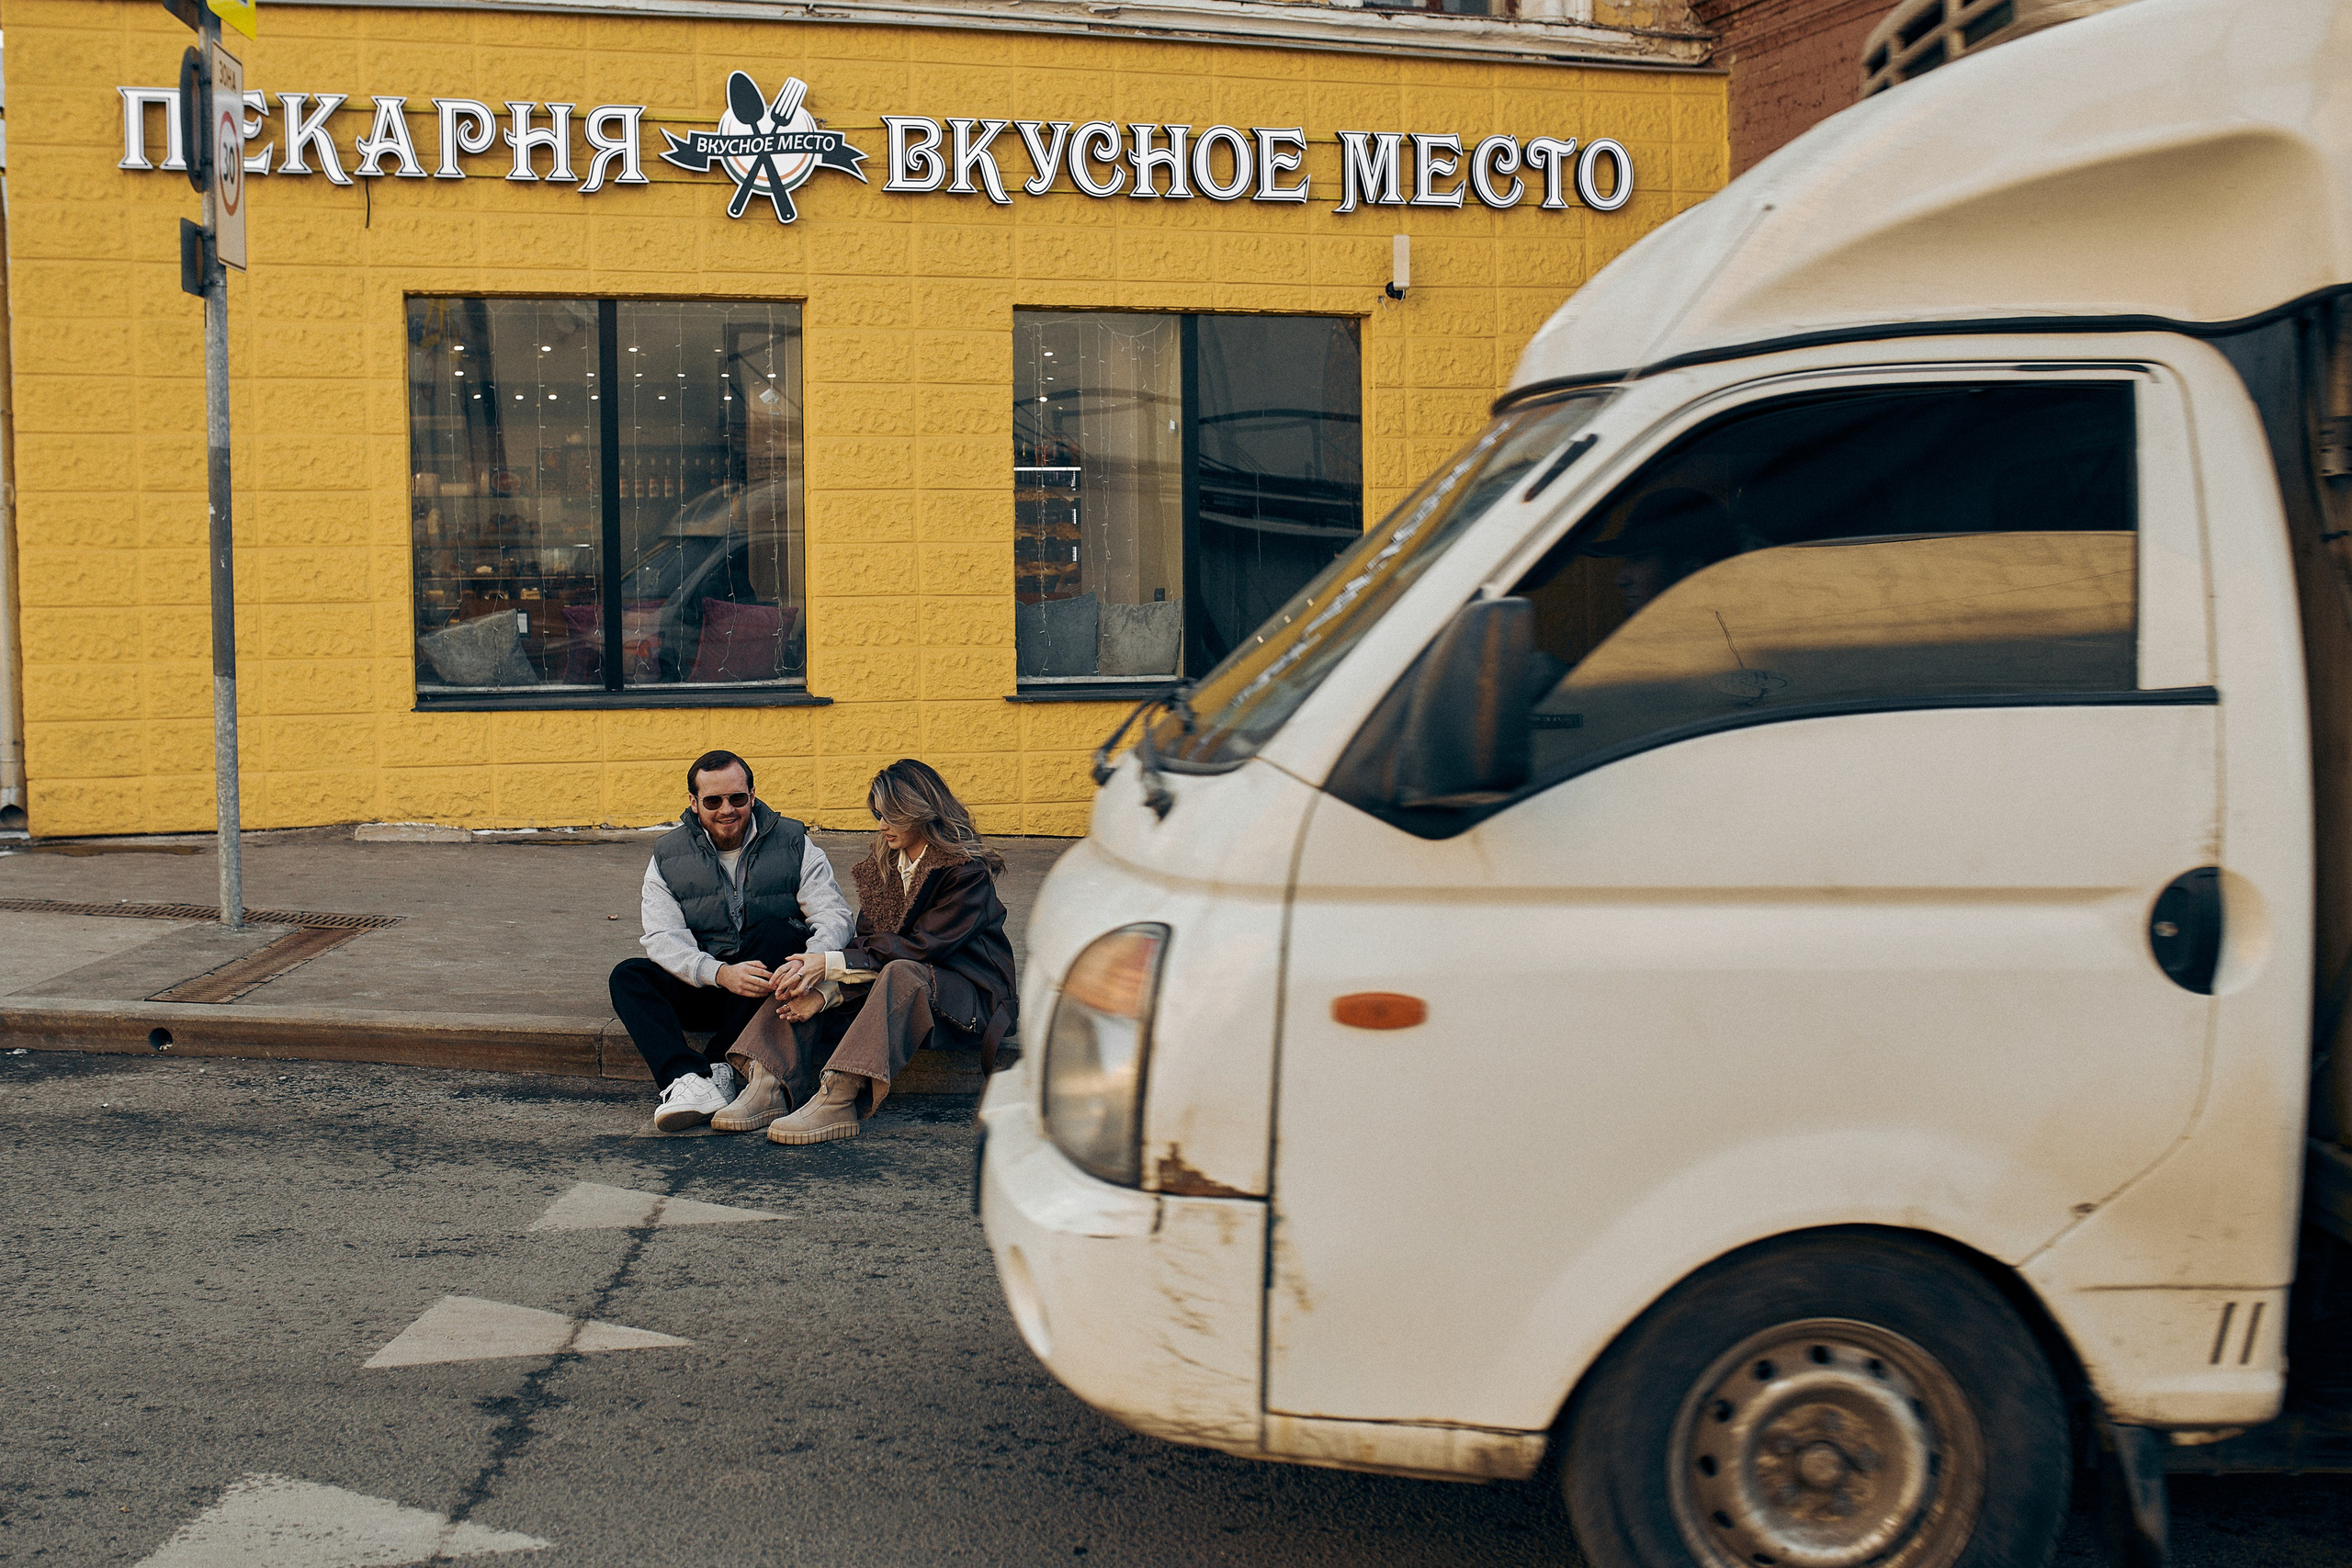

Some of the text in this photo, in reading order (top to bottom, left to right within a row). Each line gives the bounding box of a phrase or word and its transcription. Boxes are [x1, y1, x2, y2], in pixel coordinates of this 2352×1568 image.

[219, 60, 237, 93] ЗОНА
[223, 141, 235, 185] 30
[695, 134, 836, 154] ВКУСНОЕ МЕСТО
[880, 115, 1311, 205] ВКУСНОЕ
[1331, 130, 1634, 213] МЕСТО
